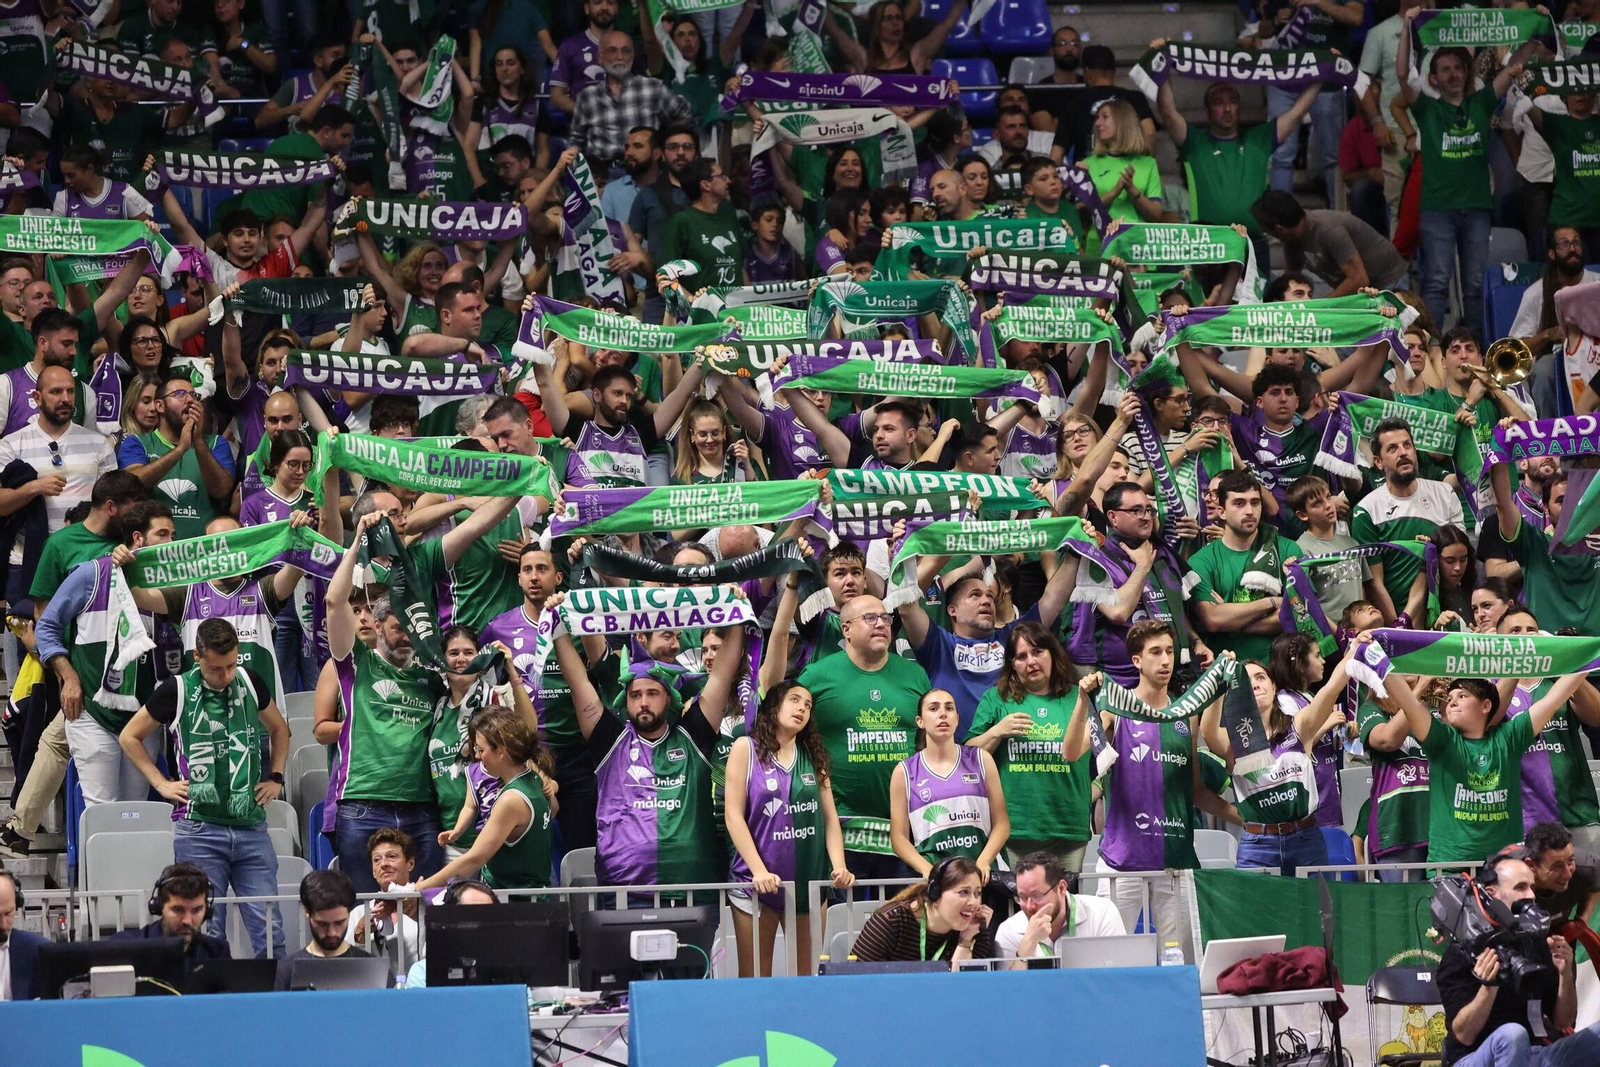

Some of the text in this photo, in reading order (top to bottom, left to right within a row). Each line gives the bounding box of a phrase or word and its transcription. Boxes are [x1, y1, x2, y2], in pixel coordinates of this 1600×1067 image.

[1451, 12, 1504, 27] UNICAJA
[1438, 26, 1518, 42] BALONCESTO
[1169, 44, 1320, 81] UNICAJA
[818, 121, 864, 137] Unicaja
[164, 151, 331, 186] UNICAJA
[366, 200, 522, 230] UNICAJA
[19, 218, 83, 234] UNICAJA
[6, 234, 96, 250] BALONCESTO
[932, 221, 1067, 250] Unicaja
[1145, 228, 1211, 244] UNICAJA
[1132, 244, 1226, 260] BALONCESTO
[74, 262, 104, 273] FINAL
[970, 253, 1123, 295] UNICAJA
[343, 289, 367, 309] 197
[865, 295, 918, 310] Unicaja
[1008, 306, 1076, 321] UNICAJA
[1247, 311, 1316, 327] UNICAJA
[579, 324, 676, 348] BALONCESTO
[999, 321, 1091, 339] BALONCESTO
[1232, 327, 1332, 343] BALONCESTO
[301, 352, 483, 391] UNICAJA
[858, 372, 956, 393] BALONCESTO
[1275, 453, 1306, 467] Unicaja
[612, 464, 640, 475] Unicaja
[398, 471, 462, 489] COPA DEL REY 2023
[836, 468, 1021, 498] CAMPEON
[669, 486, 742, 507] UNICAJA
[652, 502, 759, 527] BALONCESTO
[156, 536, 230, 564] UNICAJA
[946, 531, 1048, 552] BALONCESTO
[144, 551, 248, 584] BALONCESTO
[1463, 637, 1536, 655] UNICAJA
[1446, 656, 1552, 673] BALONCESTO
[879, 716, 897, 724] FOUR
[847, 727, 907, 751] CAMPEONES
[856, 743, 895, 752] BELGRADO
[1016, 753, 1052, 761] BELGRADO
[1152, 751, 1188, 767] Unicaja
[1270, 764, 1303, 781] Unicaja
[633, 796, 681, 811] málaga
[1259, 788, 1298, 808] málaga
[1454, 783, 1508, 807] CAMPEONES
[948, 810, 980, 822] Unicaja
[773, 826, 815, 841] málaga
[936, 834, 978, 851] málaga
